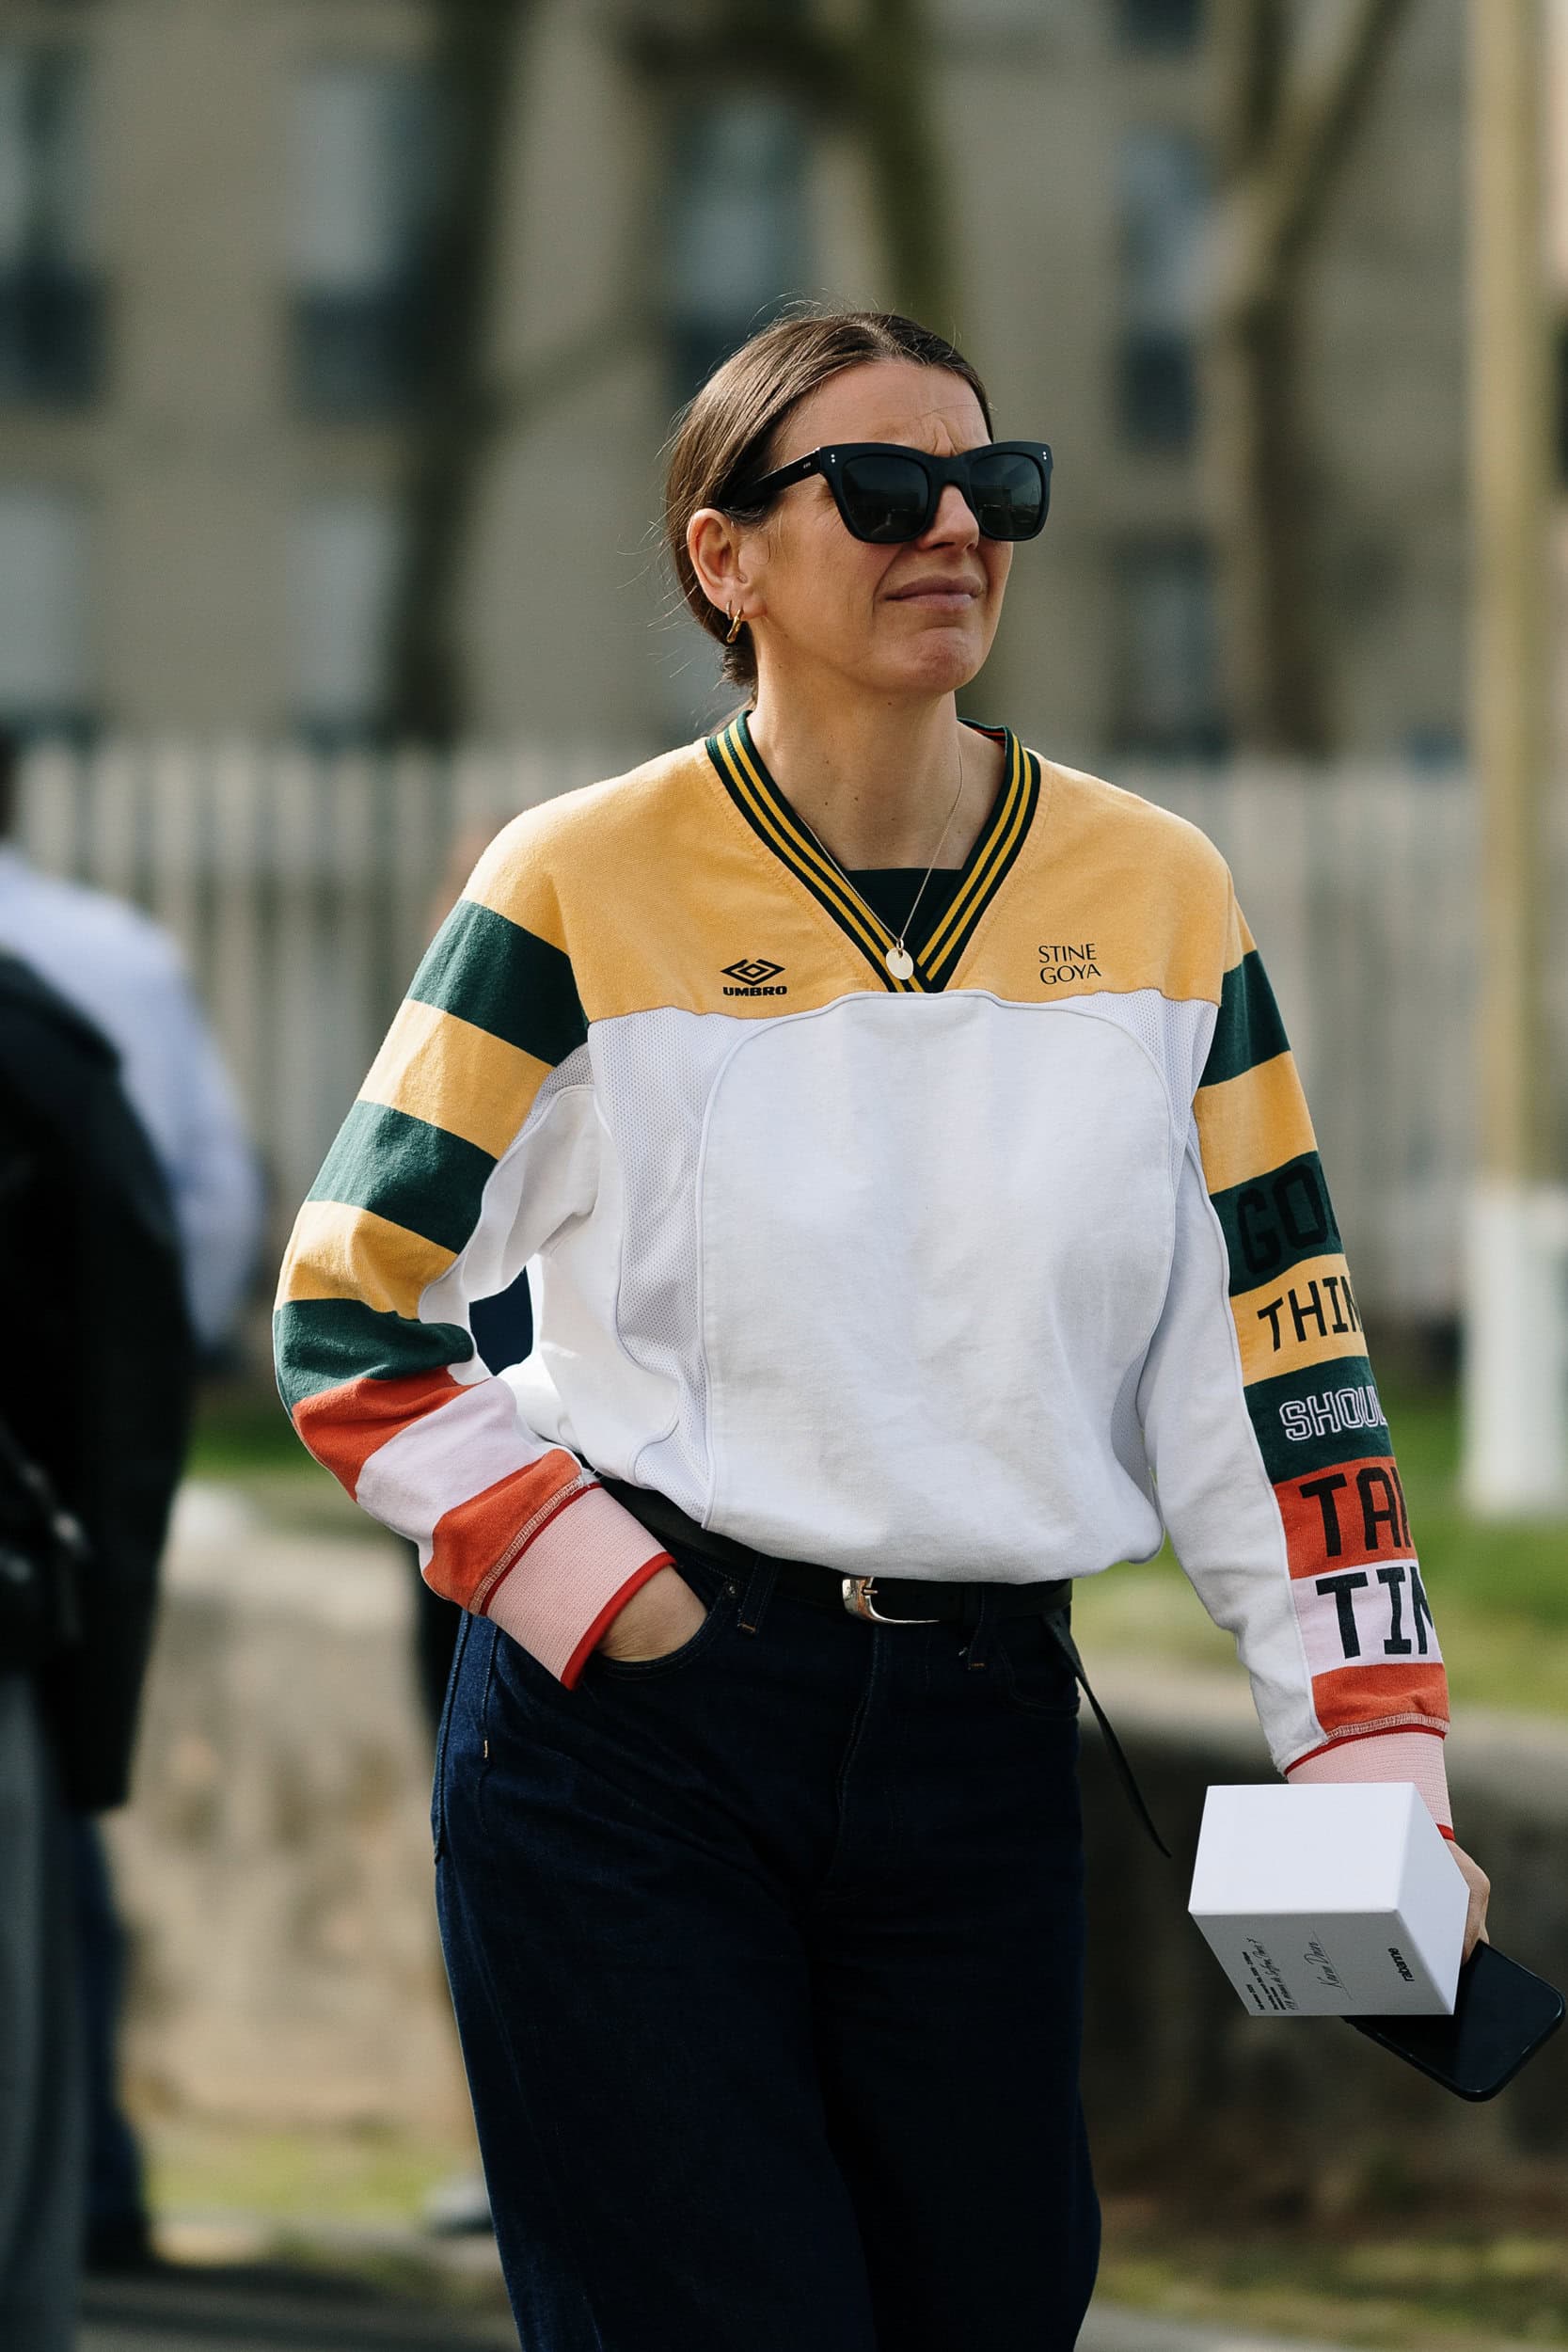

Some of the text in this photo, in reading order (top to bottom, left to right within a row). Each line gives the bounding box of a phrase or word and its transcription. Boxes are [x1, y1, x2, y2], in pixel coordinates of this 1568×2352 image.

[1037, 943, 1098, 963] STINE
[1039, 963, 1101, 985] GOYA
[722, 985, 787, 996] UMBRO
[1237, 1163, 1341, 1275] GO
[1388, 1947, 1415, 1981] rabanne
